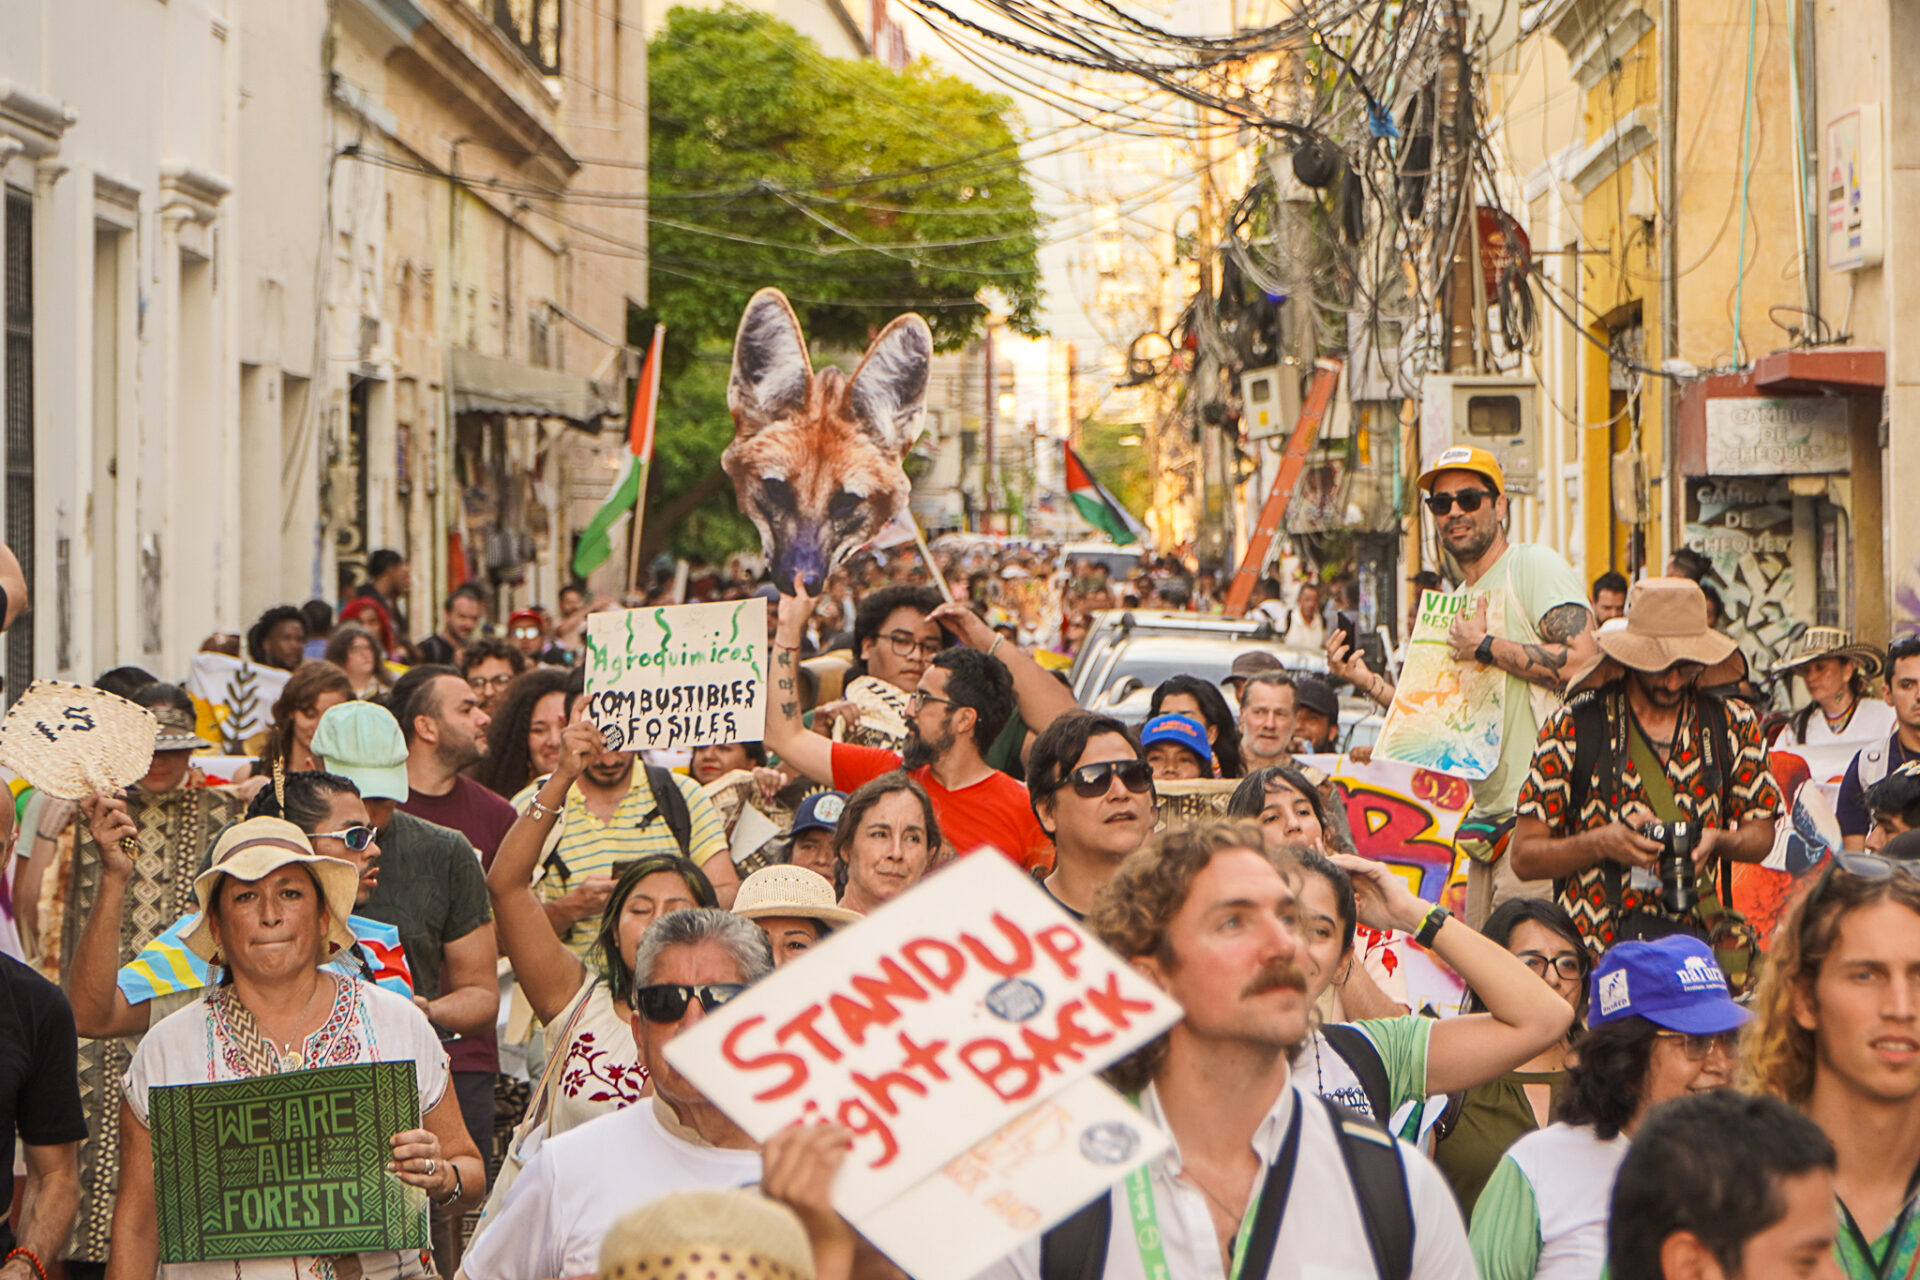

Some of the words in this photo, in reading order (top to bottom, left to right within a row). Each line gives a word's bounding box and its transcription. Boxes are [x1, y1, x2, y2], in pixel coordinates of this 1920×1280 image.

[1726, 445, 1825, 464] CHEQUES
[1760, 427, 1787, 443] DE
[1725, 511, 1750, 528] DE
[589, 679, 756, 722] COMBUSTIBLES
[627, 711, 737, 747] FOSILES
[785, 1029, 950, 1169] ight
[958, 972, 1154, 1103] BACK
[215, 1103, 270, 1145] WE
[285, 1092, 355, 1140] ARE
[256, 1143, 319, 1185] ALL
[223, 1182, 361, 1231] FORESTS
